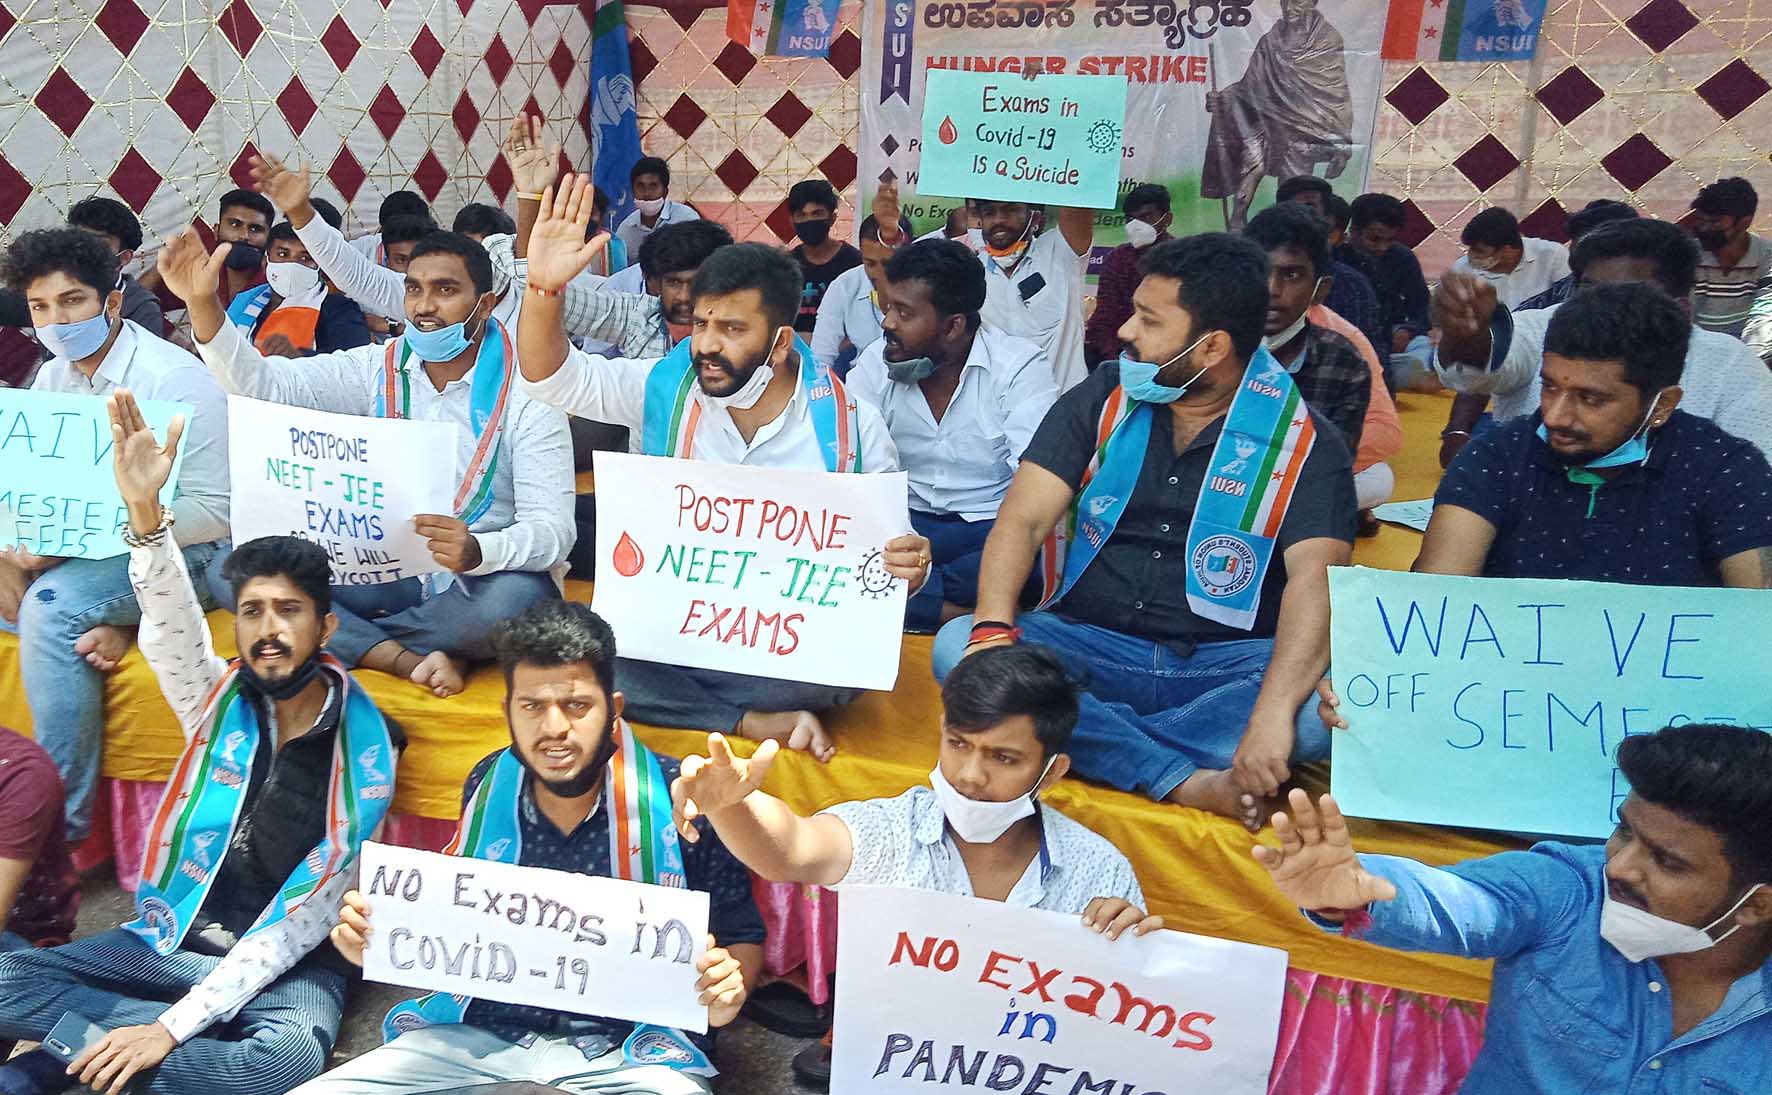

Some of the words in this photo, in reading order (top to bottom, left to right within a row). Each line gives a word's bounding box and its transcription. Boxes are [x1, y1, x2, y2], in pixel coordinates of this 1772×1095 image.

[1475, 35, 1533, 51] NSUI
[926, 56, 1066, 75] HUNGR
[1077, 56, 1209, 86] STRIKE
[982, 86, 1050, 116] Exams
[1061, 95, 1079, 117] in
[975, 122, 1057, 149] Covid-19
[996, 160, 1008, 176] a
[1011, 156, 1080, 186] Suicide
[0, 409, 155, 465] AIV
[289, 427, 369, 463] POSTPONE
[266, 457, 315, 487] NEET
[340, 473, 385, 509] JEE
[305, 501, 385, 541] EXAMS
[675, 484, 852, 552] POSTPONE
[329, 567, 403, 586] YCOTT
[354, 547, 401, 566] WILL
[656, 544, 757, 590] NEET
[780, 557, 852, 608] JEE
[679, 600, 805, 656] EXAMS
[1376, 596, 1714, 680] WAIVE
[1346, 672, 1430, 712] OFF
[368, 865, 423, 902] NO
[453, 872, 608, 946] Exams
[630, 898, 695, 965] in
[888, 931, 960, 972] NO
[997, 998, 1058, 1044] in
[872, 1033, 1167, 1095] PANDEM
